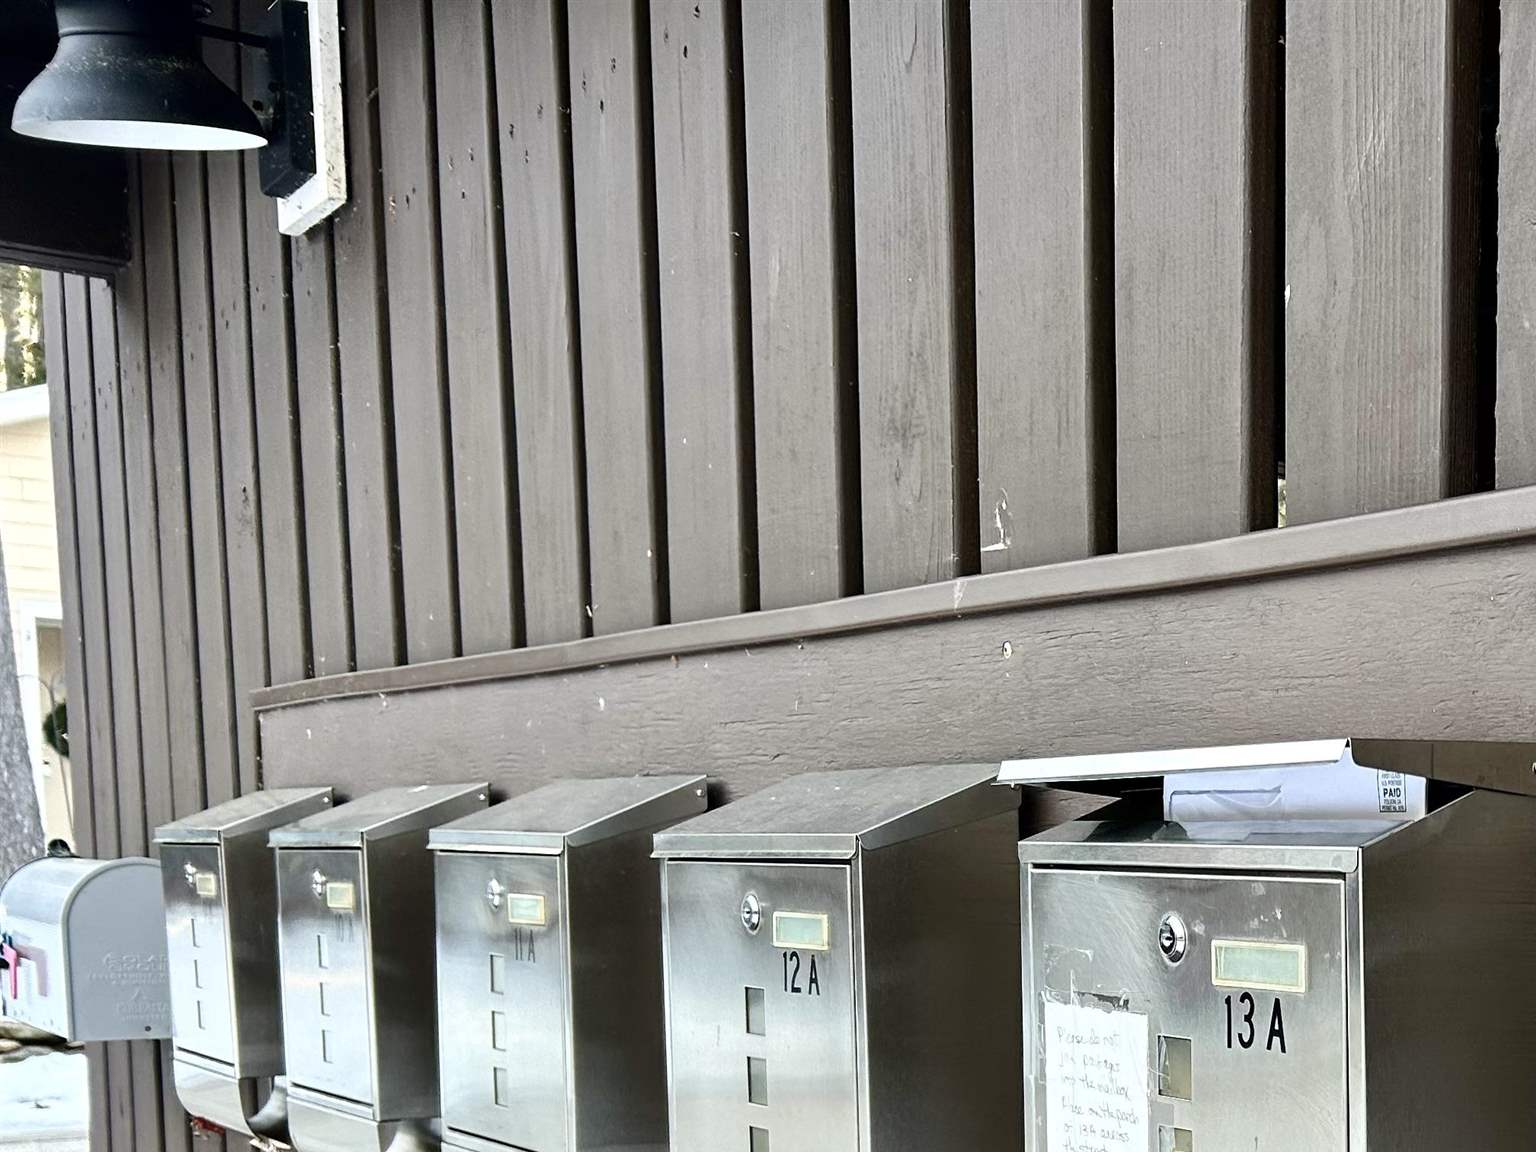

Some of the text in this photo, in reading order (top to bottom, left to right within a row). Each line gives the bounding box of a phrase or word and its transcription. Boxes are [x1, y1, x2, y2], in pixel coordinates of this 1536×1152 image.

[1383, 788, 1402, 798] PAID
[514, 927, 536, 963] 11 A
[782, 950, 820, 995] 12 A
[1224, 991, 1287, 1054] 13 A
